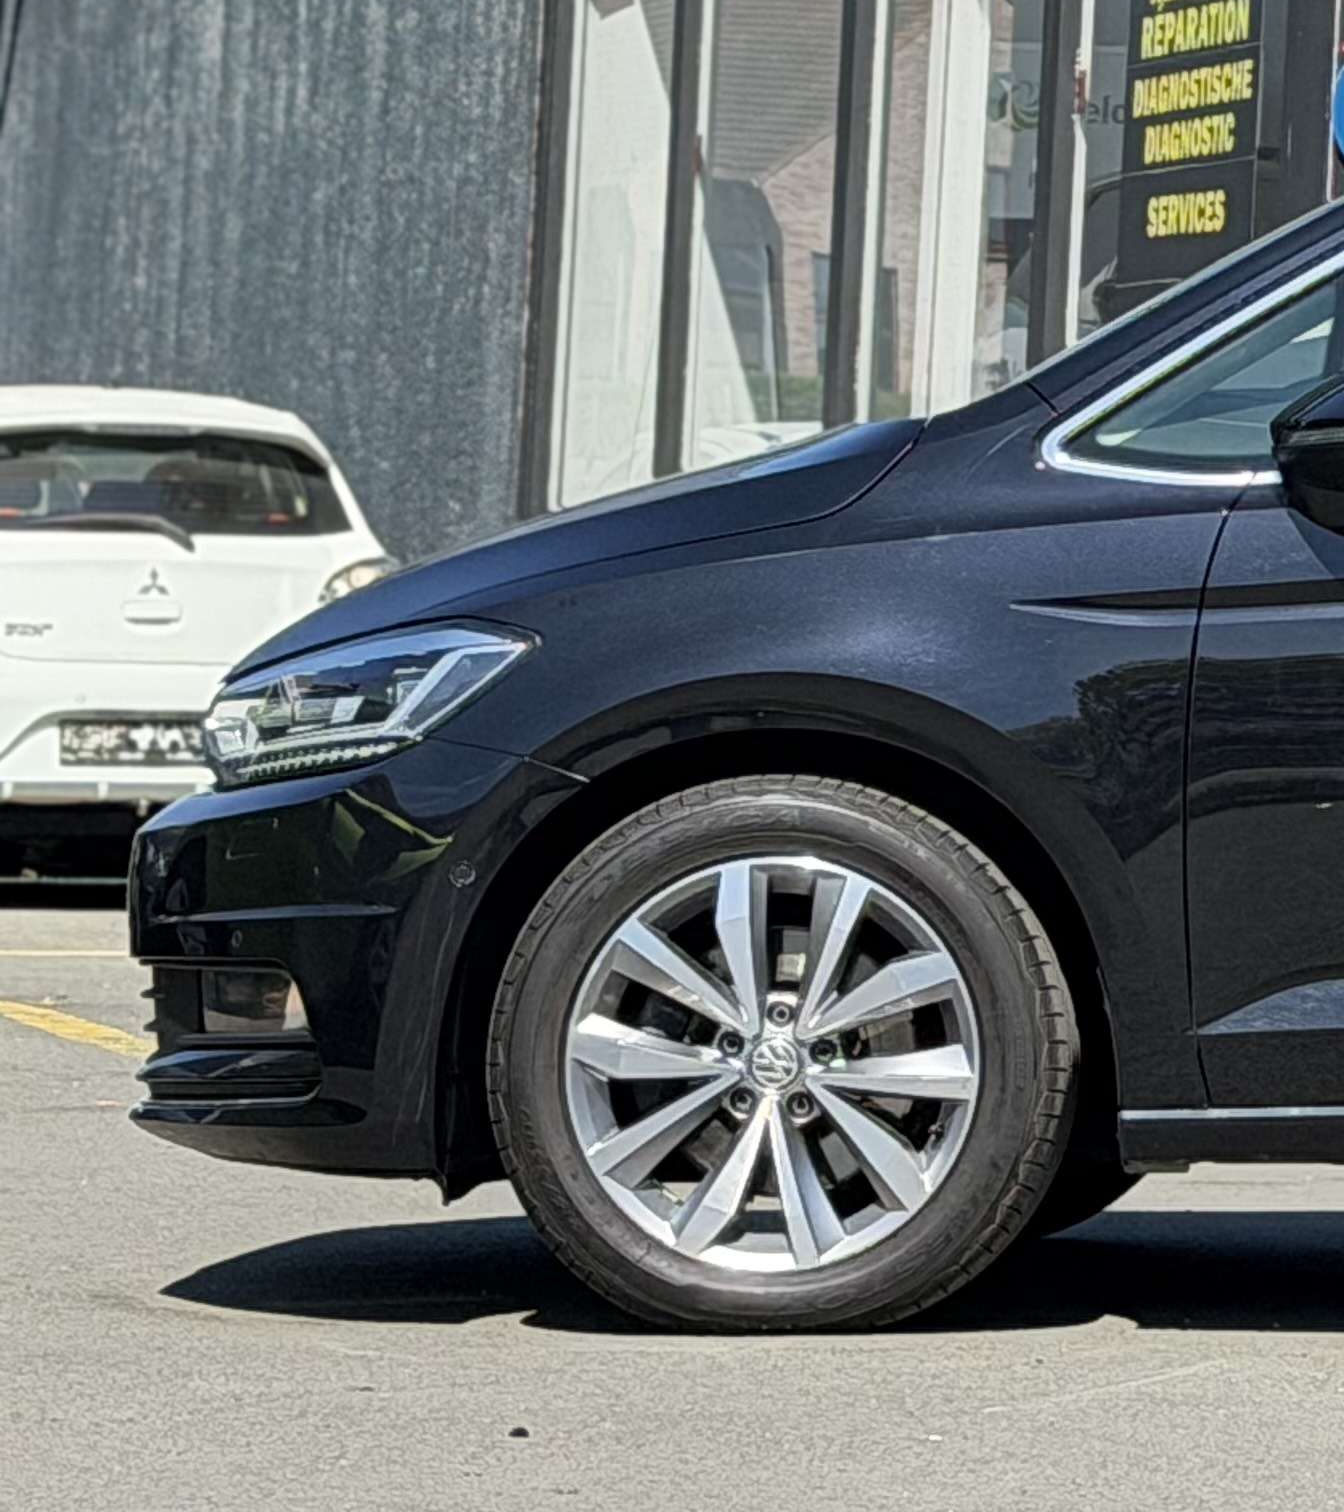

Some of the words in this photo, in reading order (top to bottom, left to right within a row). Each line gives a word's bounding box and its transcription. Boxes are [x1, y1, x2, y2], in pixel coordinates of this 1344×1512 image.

[1132, 58, 1254, 120] DIAGNOSTISCHE
[1143, 112, 1236, 165] DIAGNOSTIC
[1146, 189, 1227, 239] SERVICES
